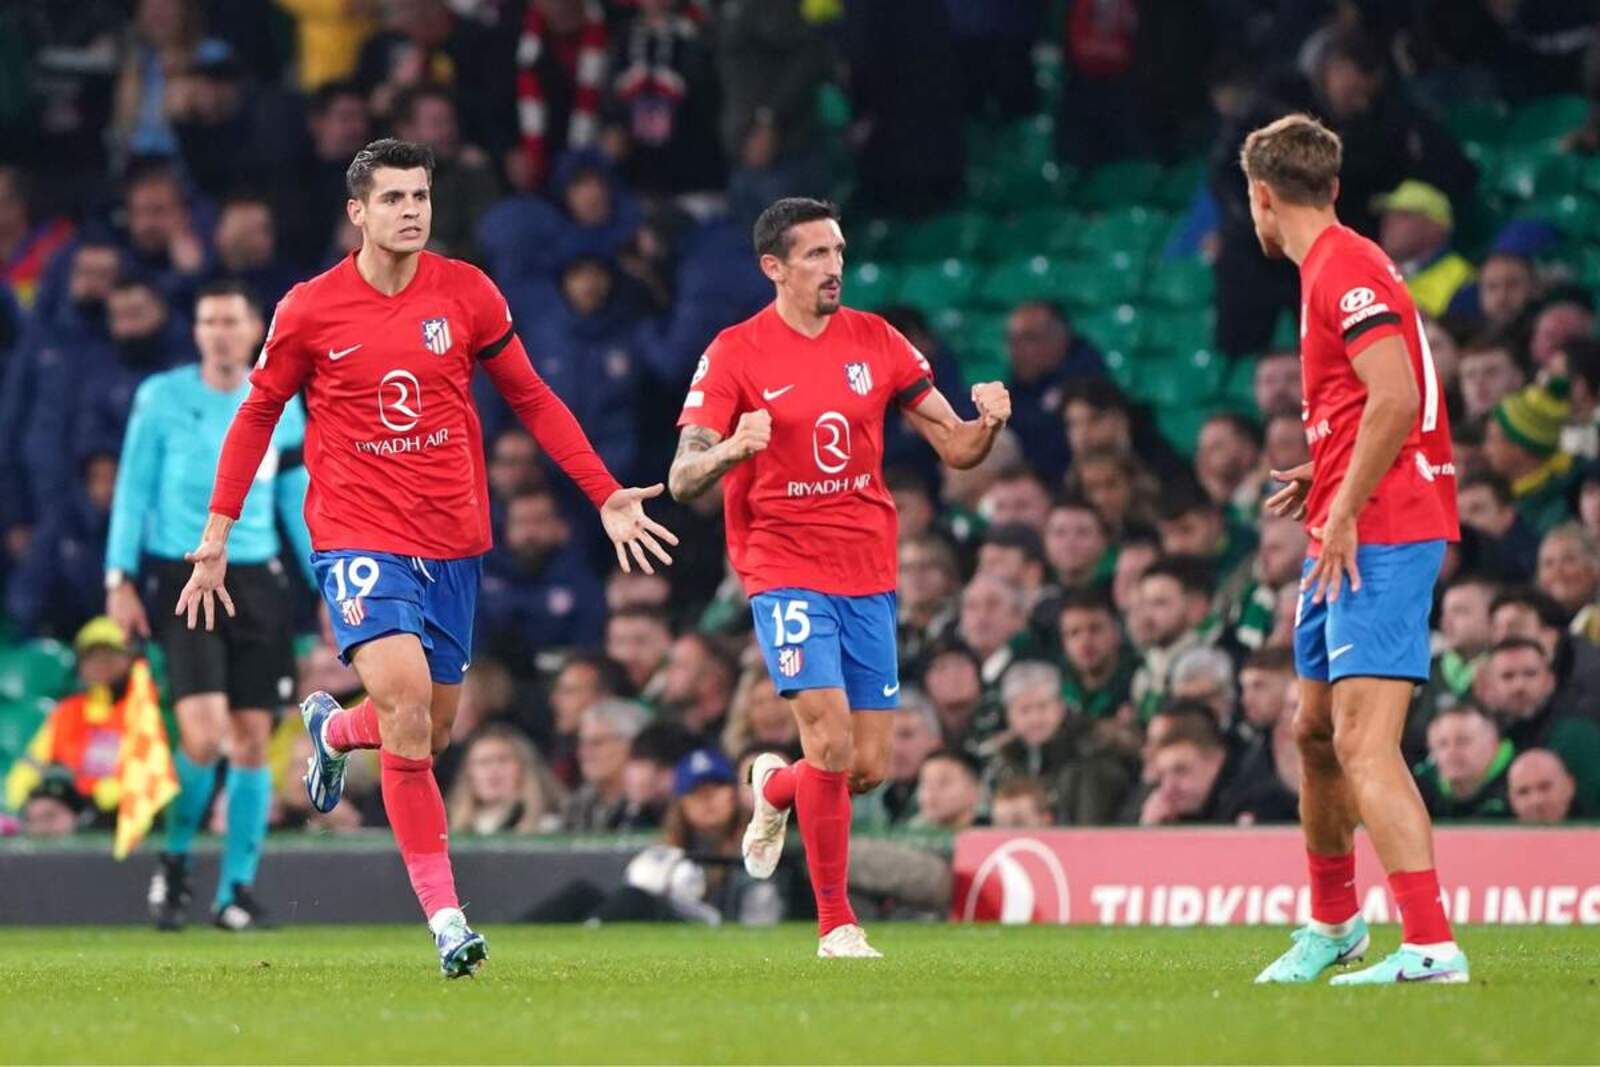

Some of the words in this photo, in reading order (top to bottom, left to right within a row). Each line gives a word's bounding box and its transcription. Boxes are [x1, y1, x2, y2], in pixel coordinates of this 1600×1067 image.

[424, 428, 449, 448] AIR
[787, 478, 848, 497] RIYADH
[331, 556, 380, 601] 19
[771, 599, 811, 647] 15
